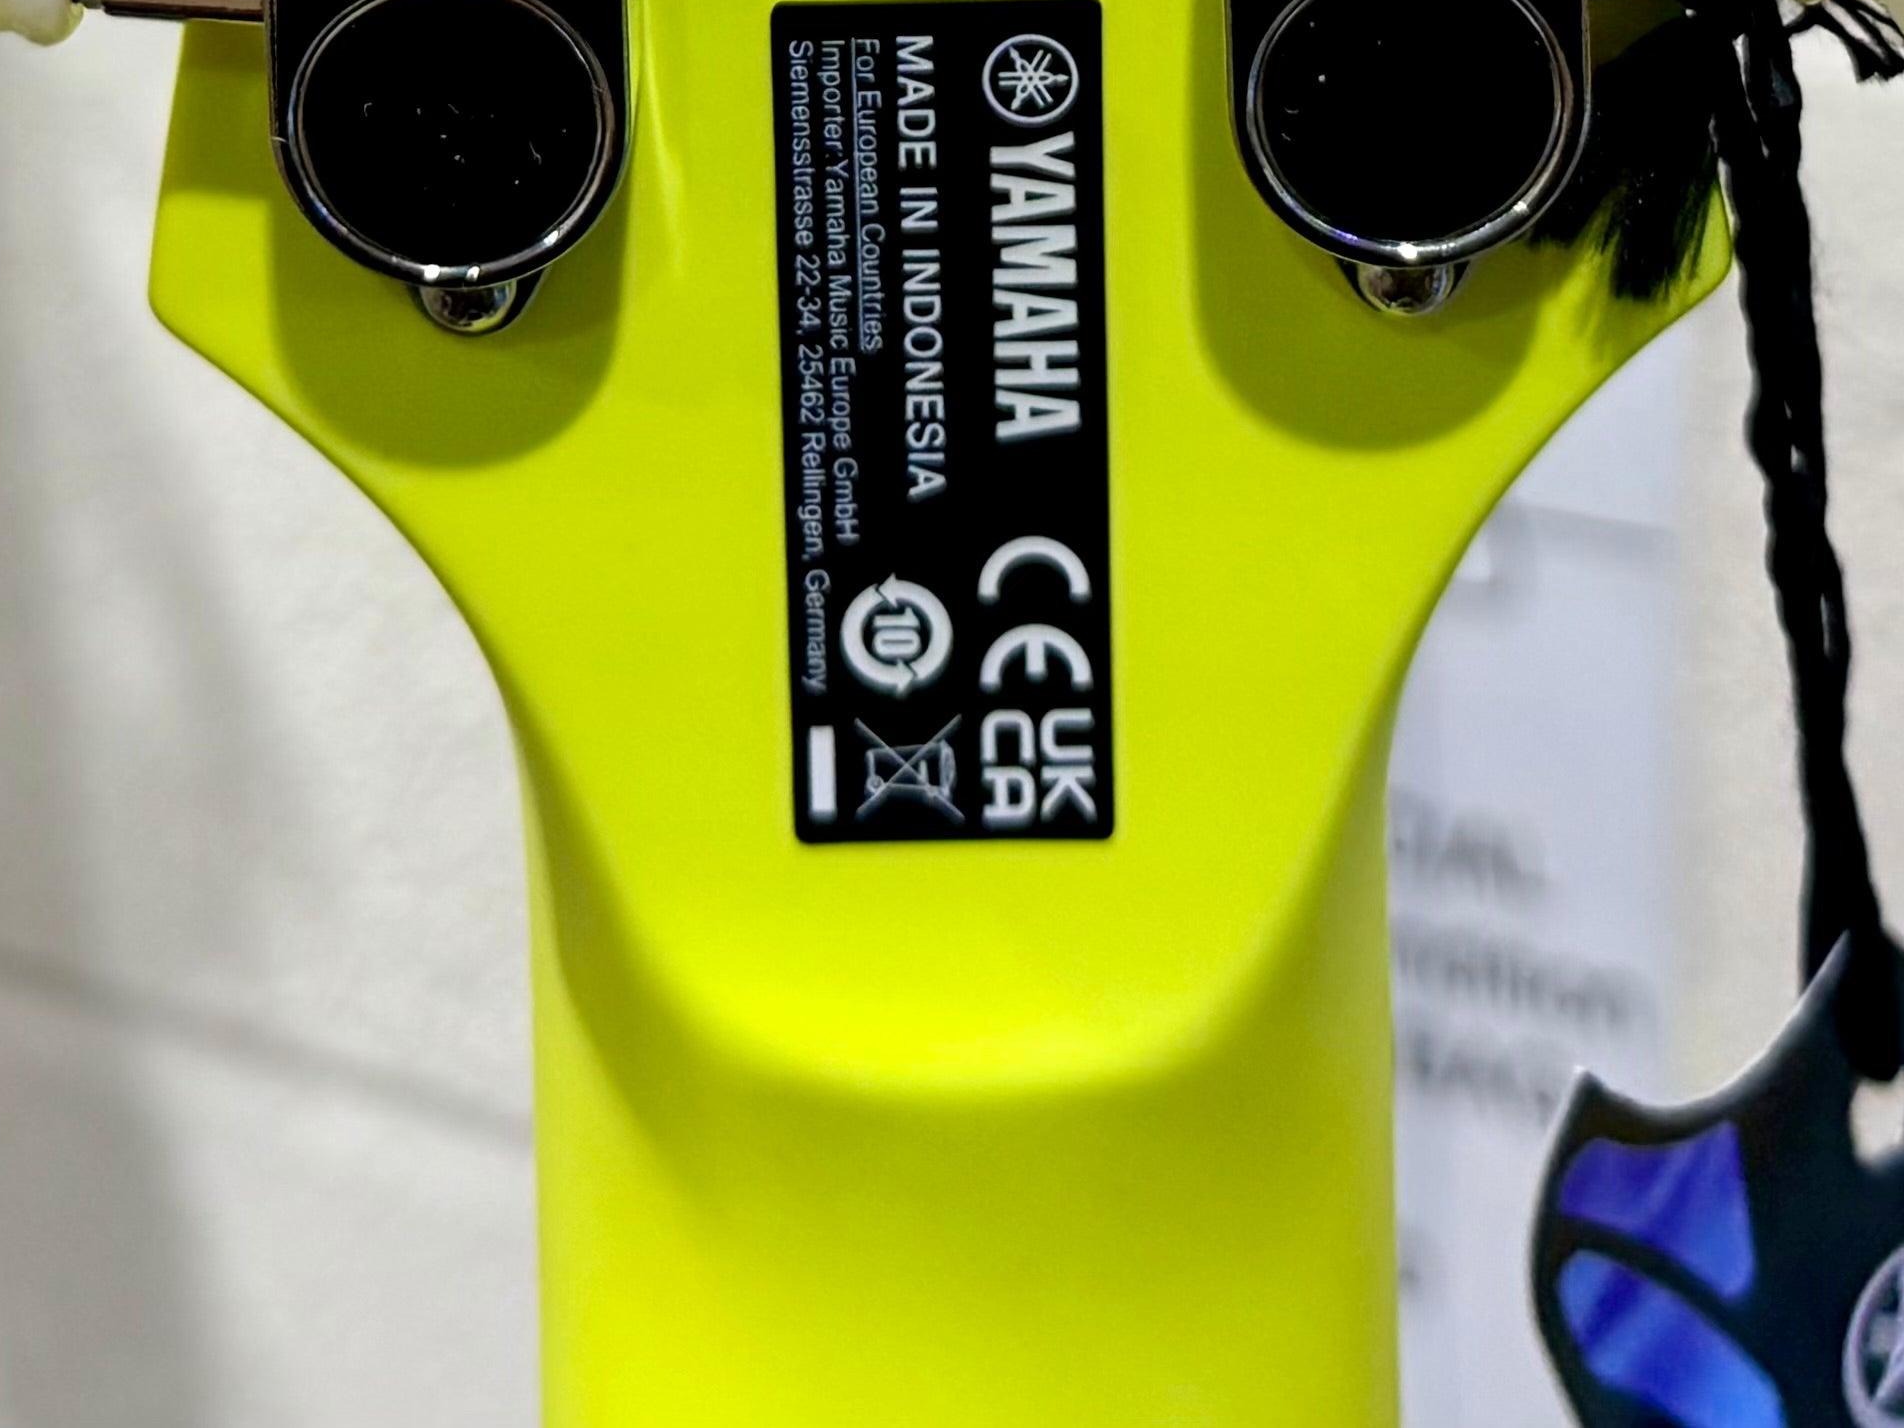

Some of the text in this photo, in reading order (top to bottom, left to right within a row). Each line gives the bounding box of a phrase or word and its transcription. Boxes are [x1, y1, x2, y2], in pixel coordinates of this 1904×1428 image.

[788, 40, 816, 245] Siemensstrasse
[856, 38, 886, 351] For European Countries
[828, 276, 852, 349] Music
[896, 35, 947, 502] MADE IN INDONESIA
[989, 131, 1082, 443] YAMAHA
[799, 345, 824, 425] 25462
[824, 358, 856, 449] Europe
[797, 433, 827, 560] Rellingen,
[832, 458, 860, 543] GmbH
[802, 570, 831, 692] Germany
[870, 608, 921, 660] 10
[977, 536, 1093, 692] CE
[980, 708, 1037, 827] CA
[1039, 708, 1096, 824] UK
